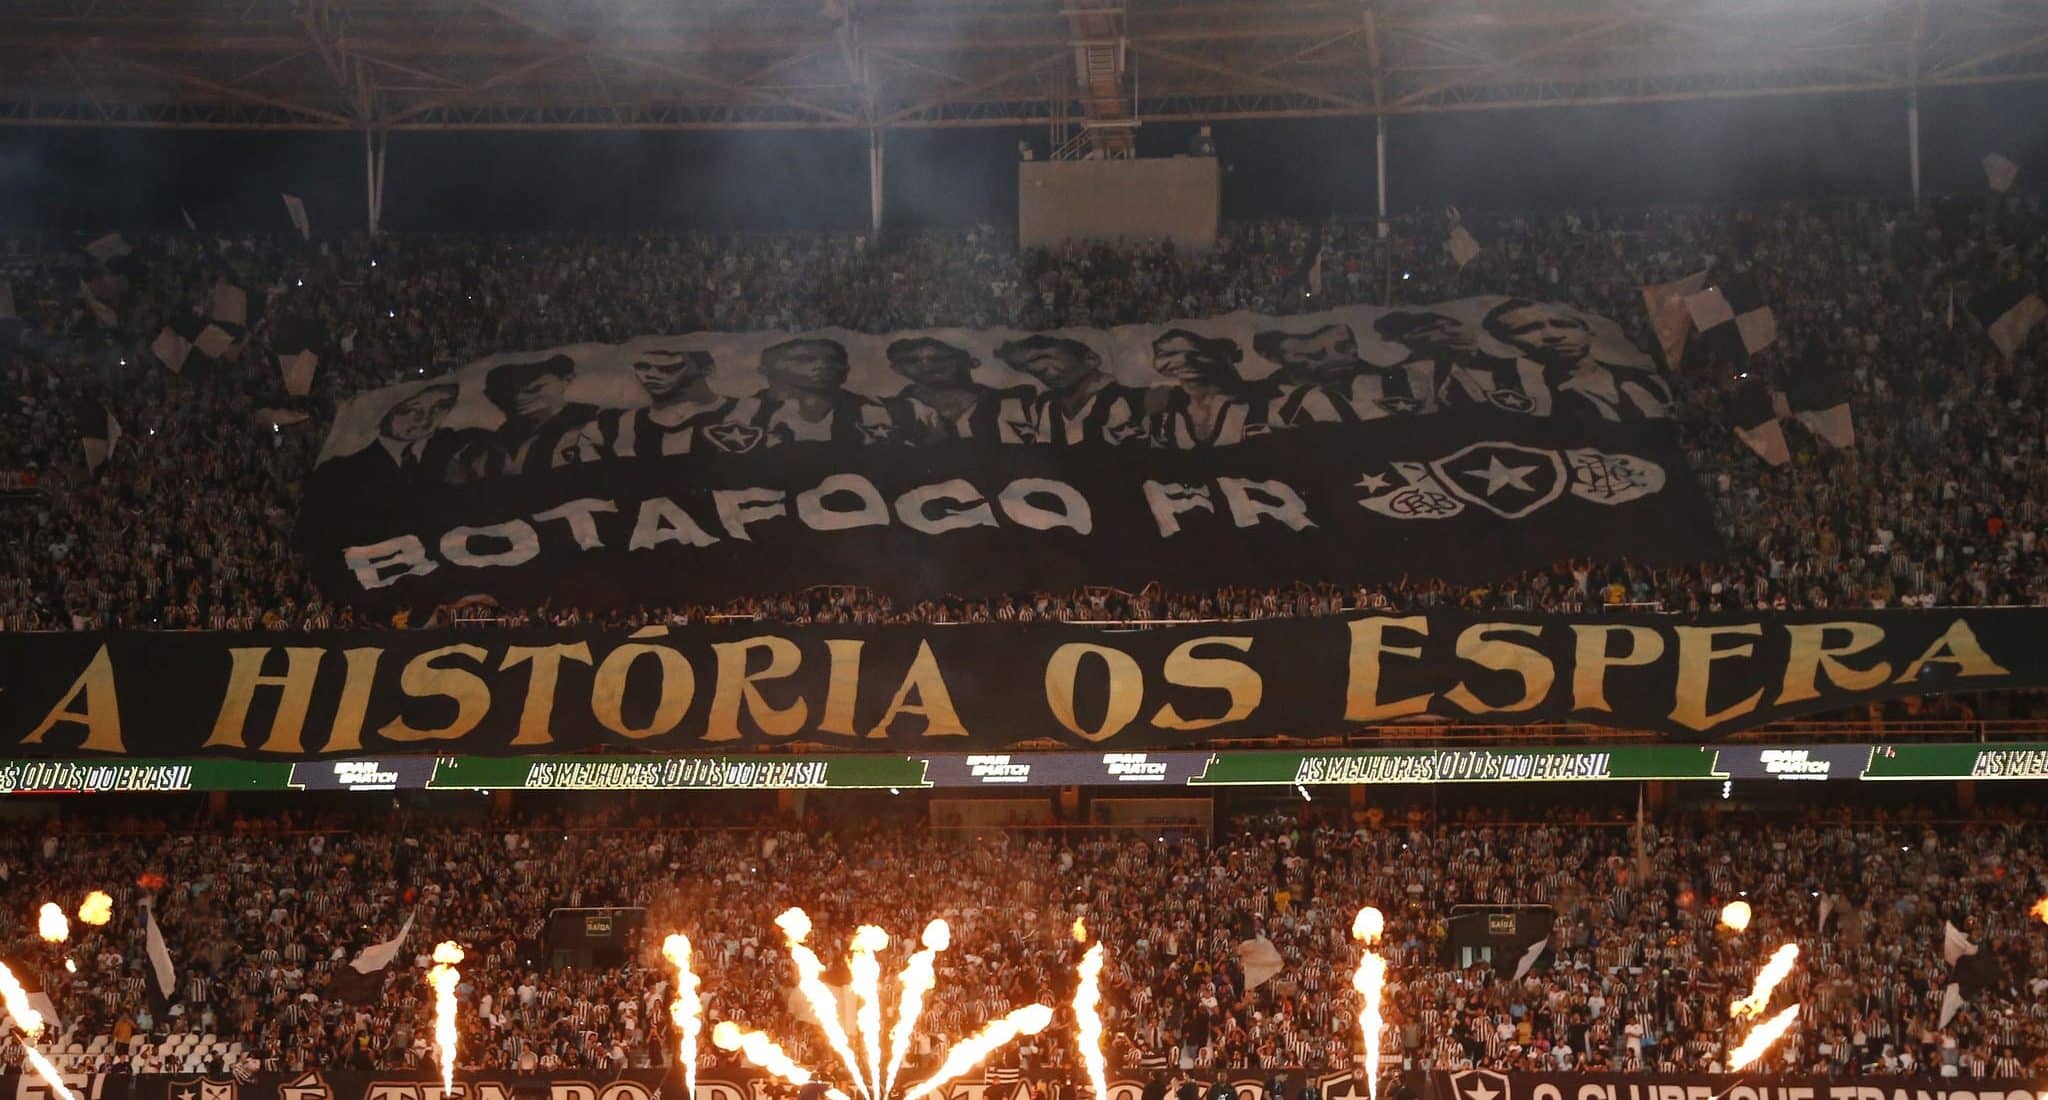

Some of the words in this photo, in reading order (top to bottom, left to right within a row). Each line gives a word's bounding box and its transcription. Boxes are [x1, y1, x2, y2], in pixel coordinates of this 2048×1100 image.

[341, 473, 1093, 590] BOTAFOGO
[1143, 476, 1320, 538] FR
[20, 643, 128, 752] A
[202, 625, 969, 753] HISTÓRIA
[1044, 635, 1263, 742] OS
[1342, 615, 2012, 731] ESPERA
[115, 766, 192, 790] BRASIL
[753, 762, 828, 785] BRASIL
[1532, 753, 1611, 778] BRASIL
